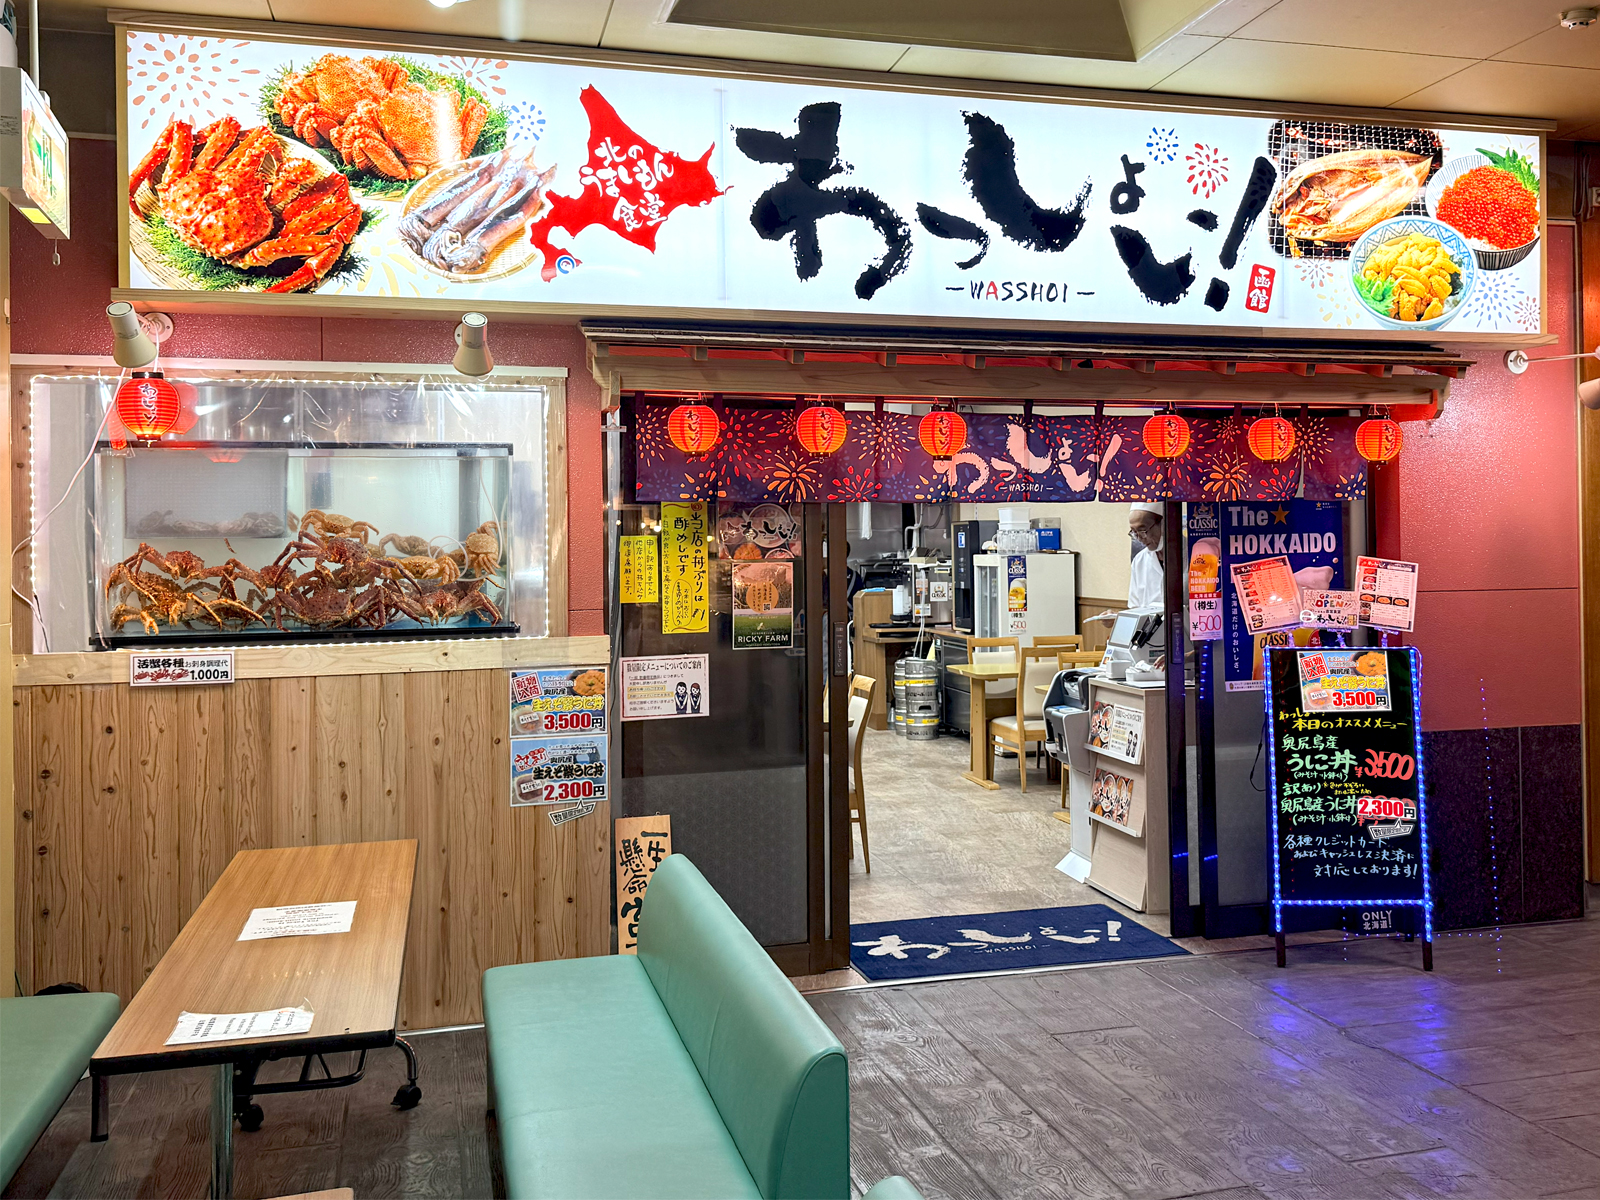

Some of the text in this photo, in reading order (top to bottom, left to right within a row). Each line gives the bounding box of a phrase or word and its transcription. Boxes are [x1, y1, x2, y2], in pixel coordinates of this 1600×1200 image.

[594, 137, 643, 167] 北の
[580, 152, 674, 198] うまいもん
[613, 192, 668, 232] 食堂
[970, 281, 1068, 303] WASSHOI
[1249, 267, 1273, 310] 函館
[1189, 518, 1218, 529] CLASSIC
[1228, 507, 1269, 527] The
[674, 517, 690, 576] 酢めしです
[1230, 532, 1337, 555] HOKKAIDO
[691, 512, 706, 602] 当店の丼ぶりは
[1192, 614, 1221, 631] ¥500
[738, 634, 788, 643] RICKY FARM
[519, 685, 539, 700] 入荷
[1332, 691, 1387, 707] 3,500円
[544, 712, 604, 731] 3,500円
[1281, 734, 1339, 751] 奥尻島産
[1287, 749, 1358, 775] うに丼
[544, 780, 605, 801] 2,300円
[1282, 782, 1321, 796] 訳あり
[1358, 798, 1415, 818] 2,300円
[985, 944, 1037, 953] WASSHOI
